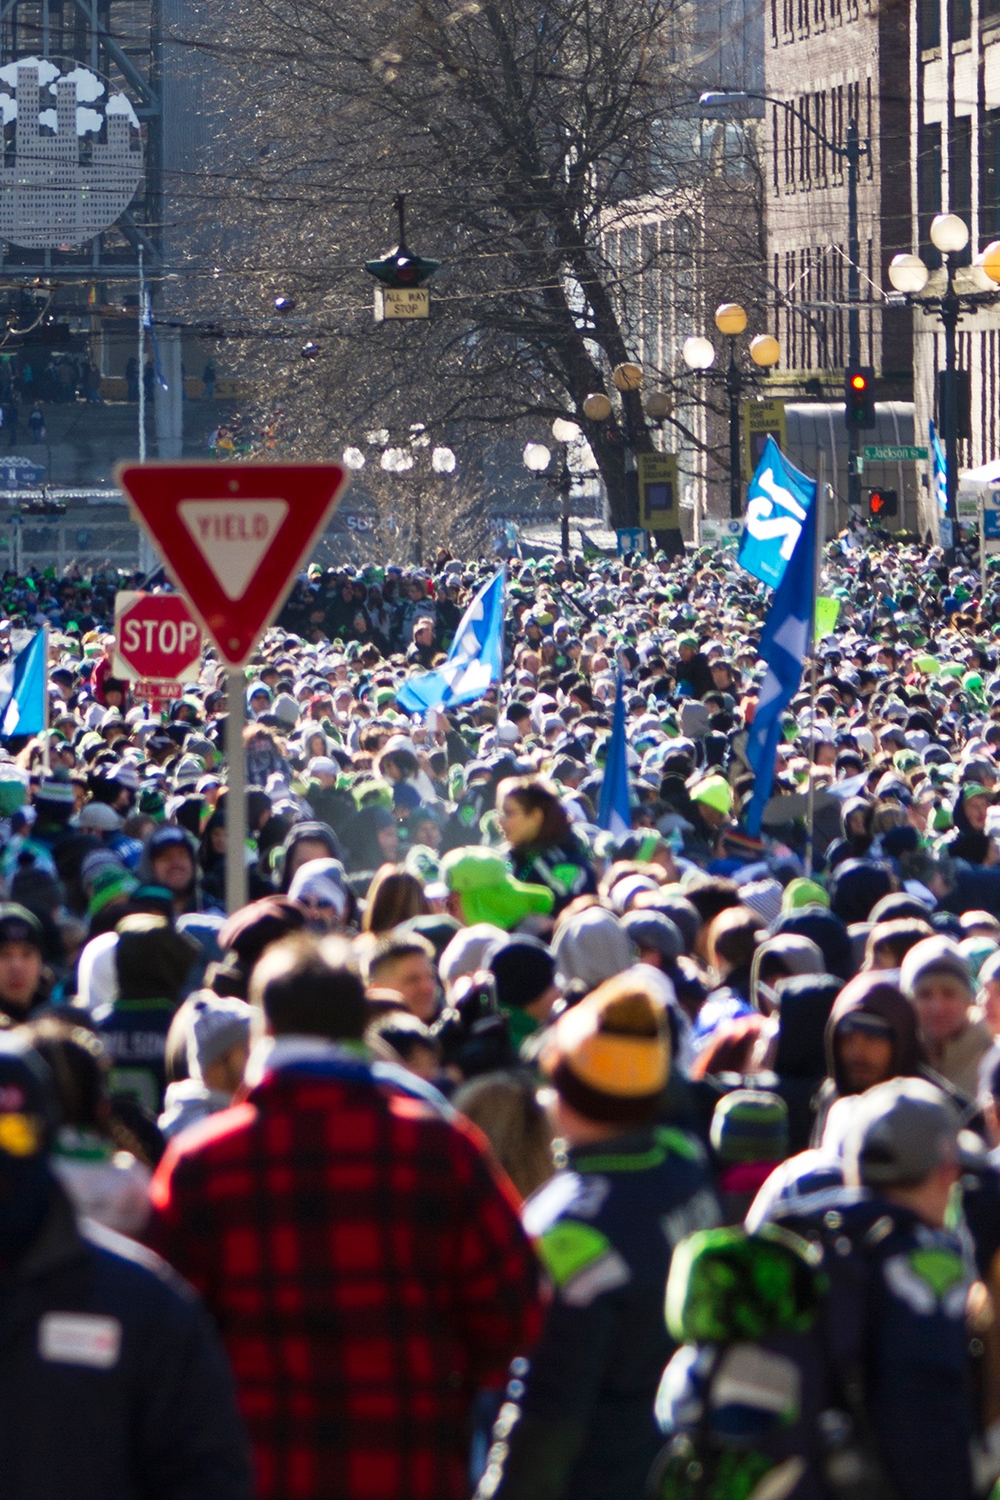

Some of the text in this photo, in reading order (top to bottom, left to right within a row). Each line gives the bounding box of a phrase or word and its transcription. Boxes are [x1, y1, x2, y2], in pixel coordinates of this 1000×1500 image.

[385, 291, 428, 302] ALL WAY
[394, 303, 419, 314] STOP
[873, 445, 909, 459] Jackson
[197, 513, 269, 541] YIELD
[123, 619, 197, 655] STOP
[135, 682, 181, 698] ALL WAY
